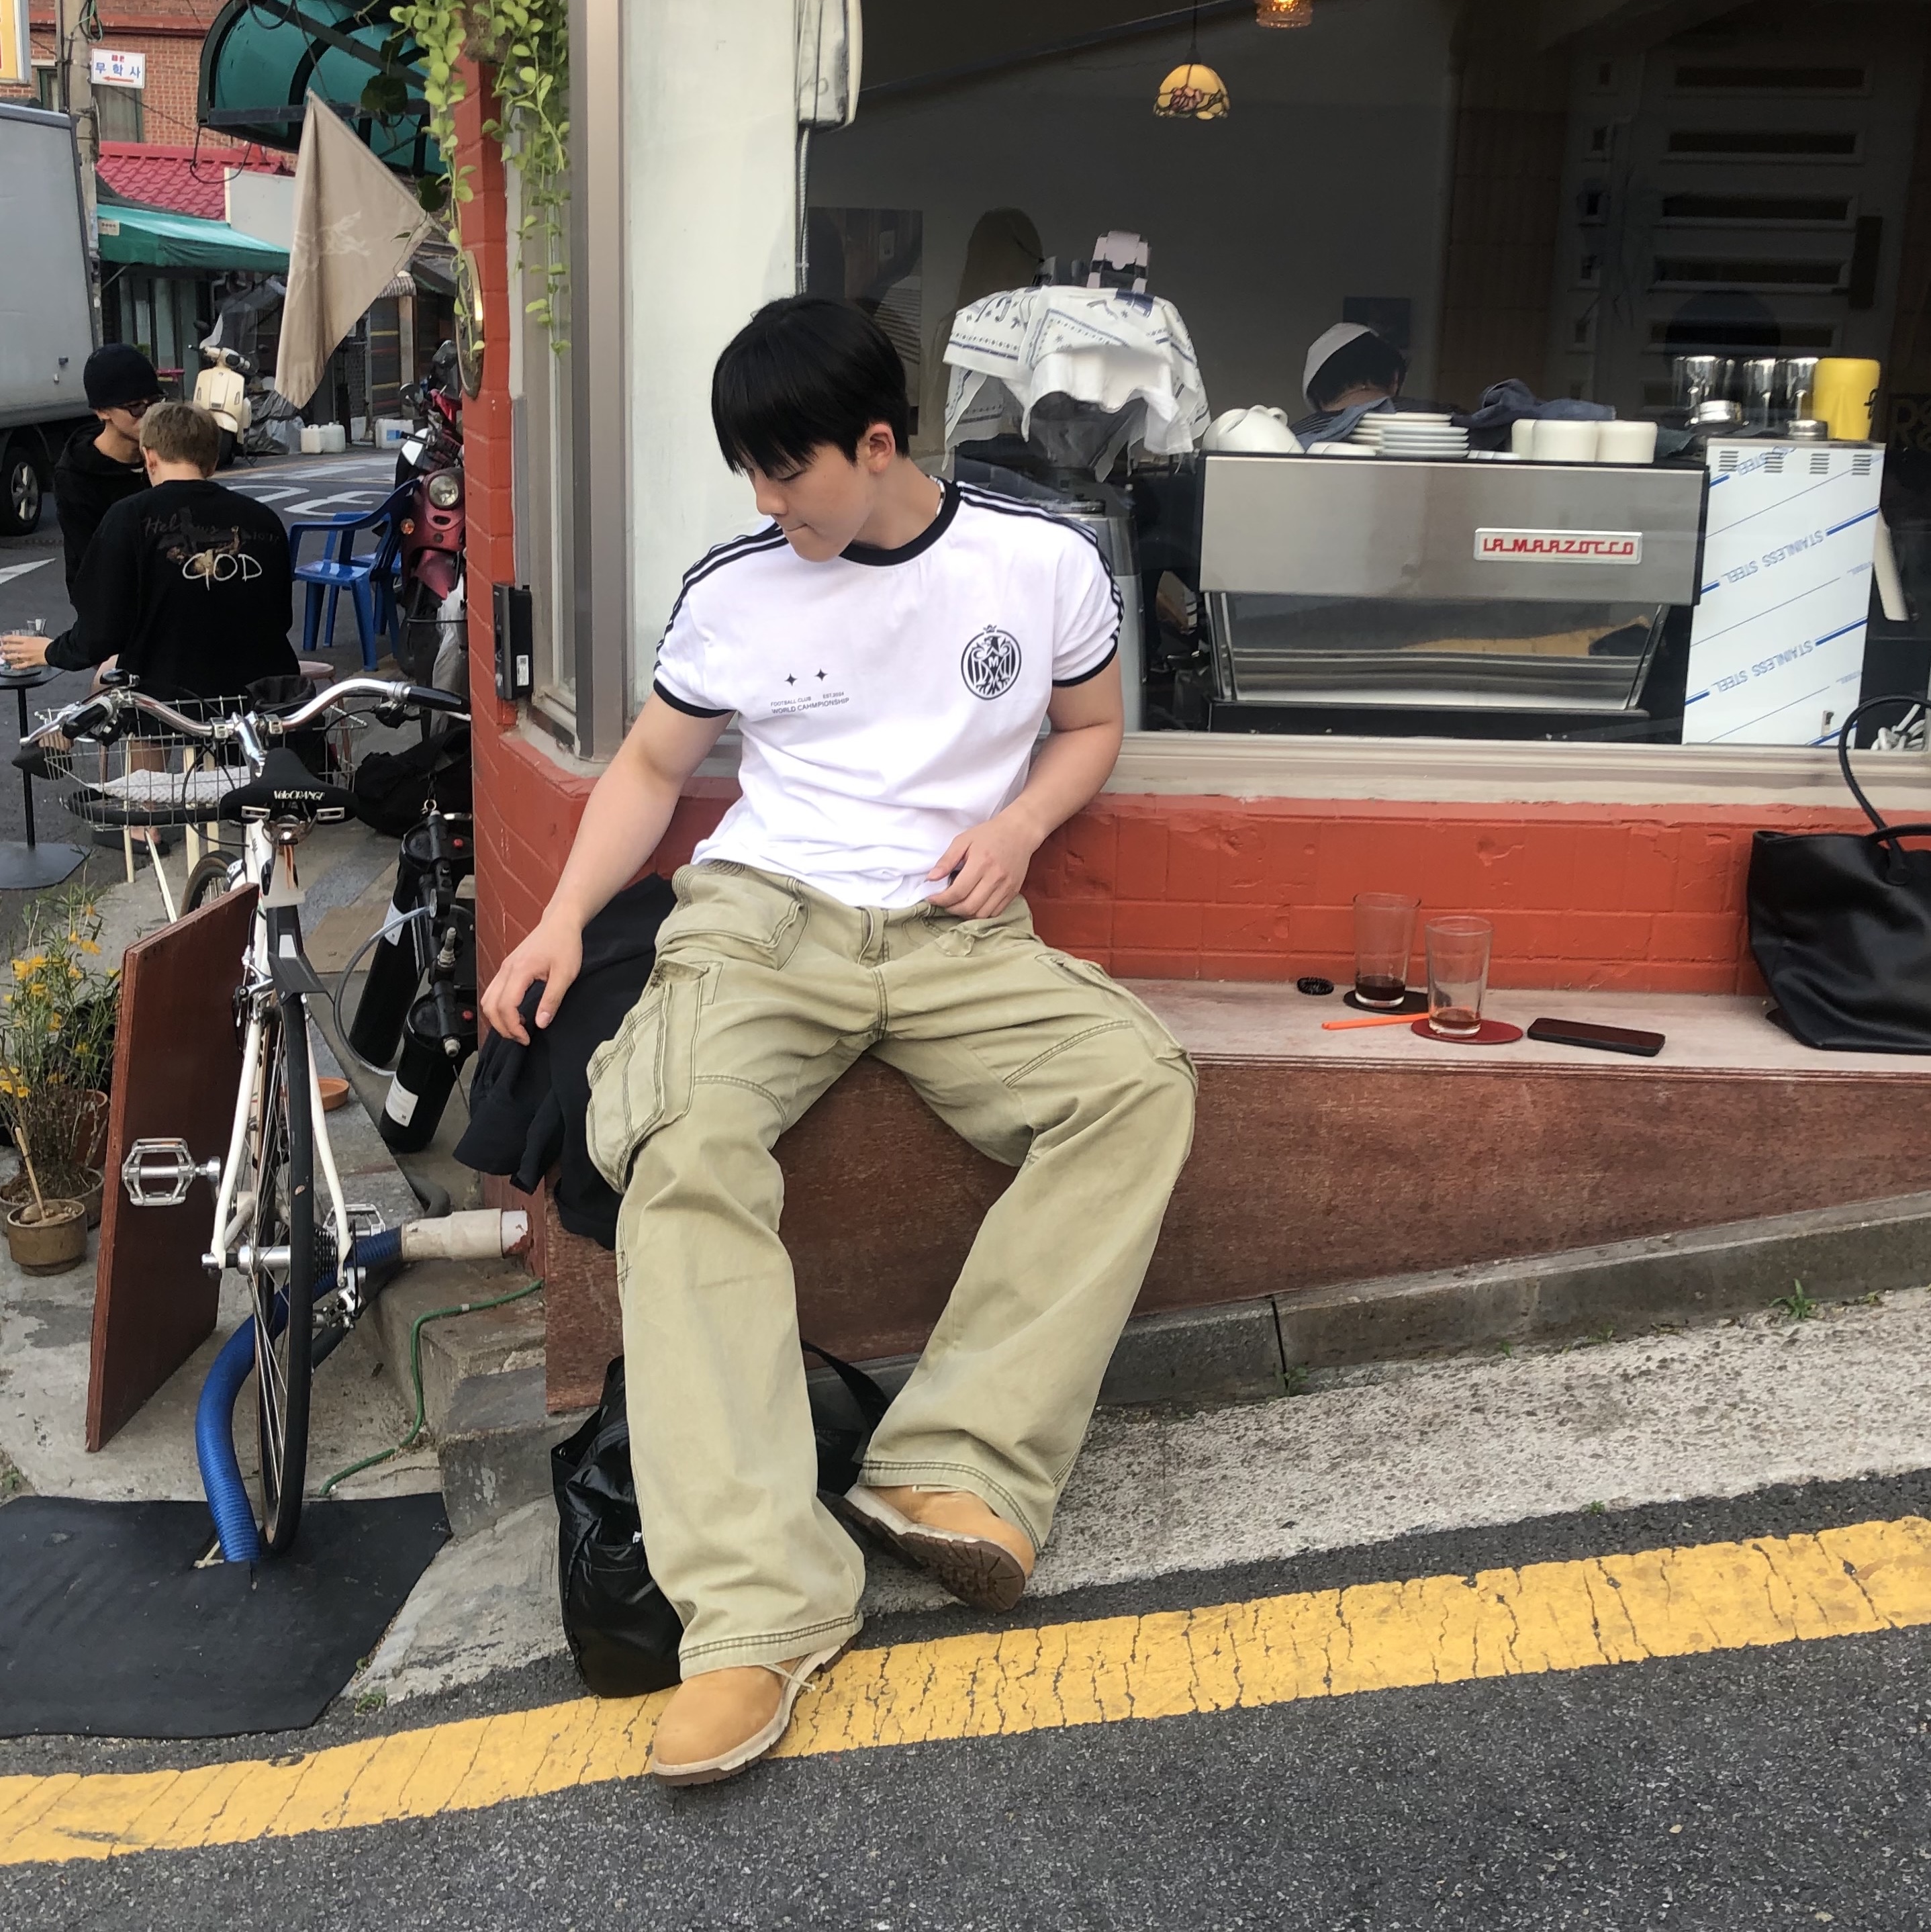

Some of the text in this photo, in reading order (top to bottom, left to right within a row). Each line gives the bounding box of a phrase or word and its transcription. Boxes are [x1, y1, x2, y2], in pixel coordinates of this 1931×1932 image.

[1483, 538, 1504, 552] LA
[1721, 530, 1824, 584] STAINLESS STEEL
[182, 553, 263, 591] GOD
[1711, 640, 1814, 692] STAINLESS STEEL
[771, 706, 796, 714] WORLD
